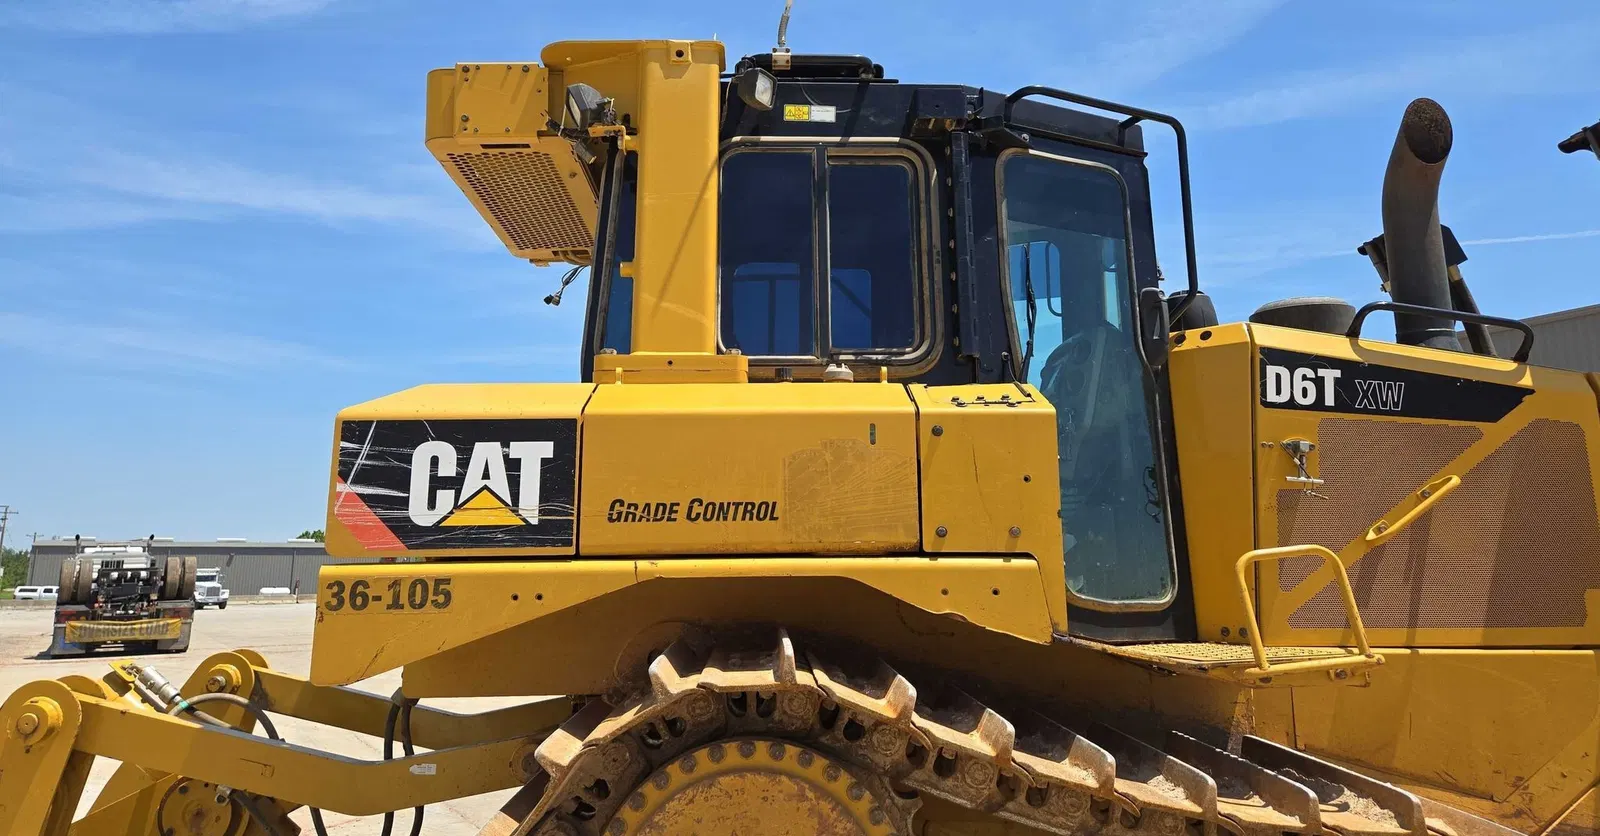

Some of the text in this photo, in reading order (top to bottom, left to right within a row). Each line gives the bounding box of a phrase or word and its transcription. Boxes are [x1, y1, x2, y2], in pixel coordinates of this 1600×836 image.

[1265, 364, 1405, 411] D6T XW
[408, 440, 555, 527] CAT
[607, 497, 780, 523] GRADE CONTROL
[324, 578, 452, 611] 36-105
[79, 621, 169, 639] OVERSIZE LOAD
